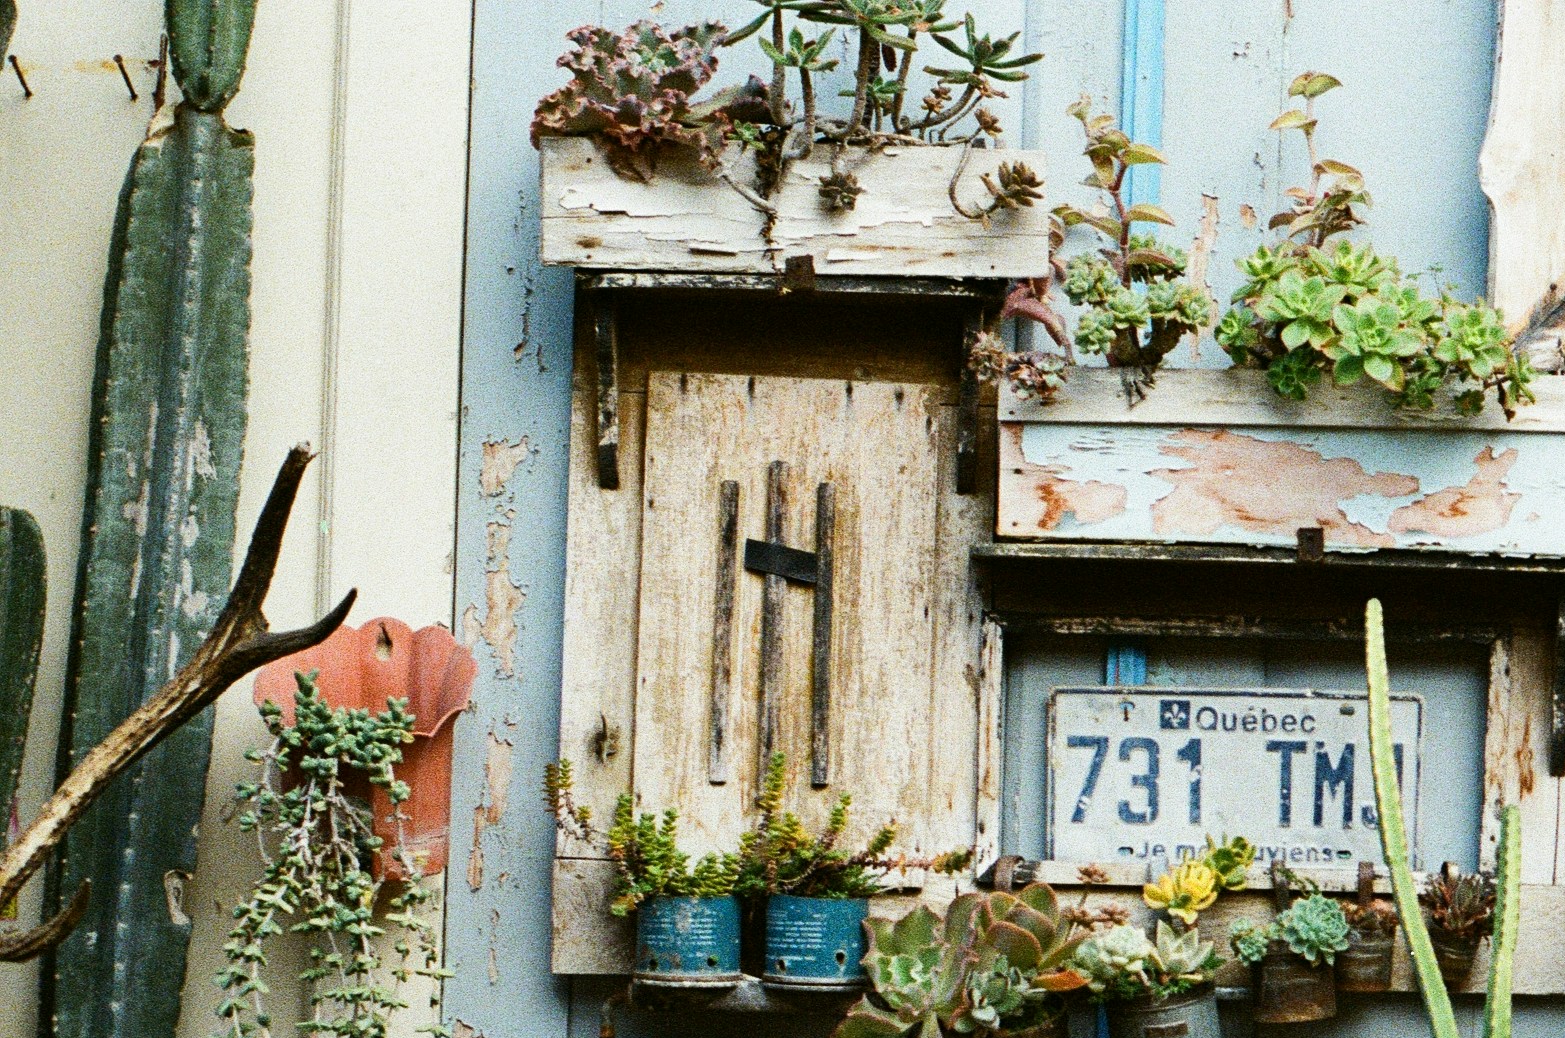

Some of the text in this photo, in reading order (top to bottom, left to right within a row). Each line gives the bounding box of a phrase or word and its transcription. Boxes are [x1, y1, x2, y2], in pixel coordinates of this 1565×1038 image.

[1195, 705, 1317, 734] Québec
[1067, 735, 1203, 825] 731
[1136, 841, 1334, 863] Je m uviens
